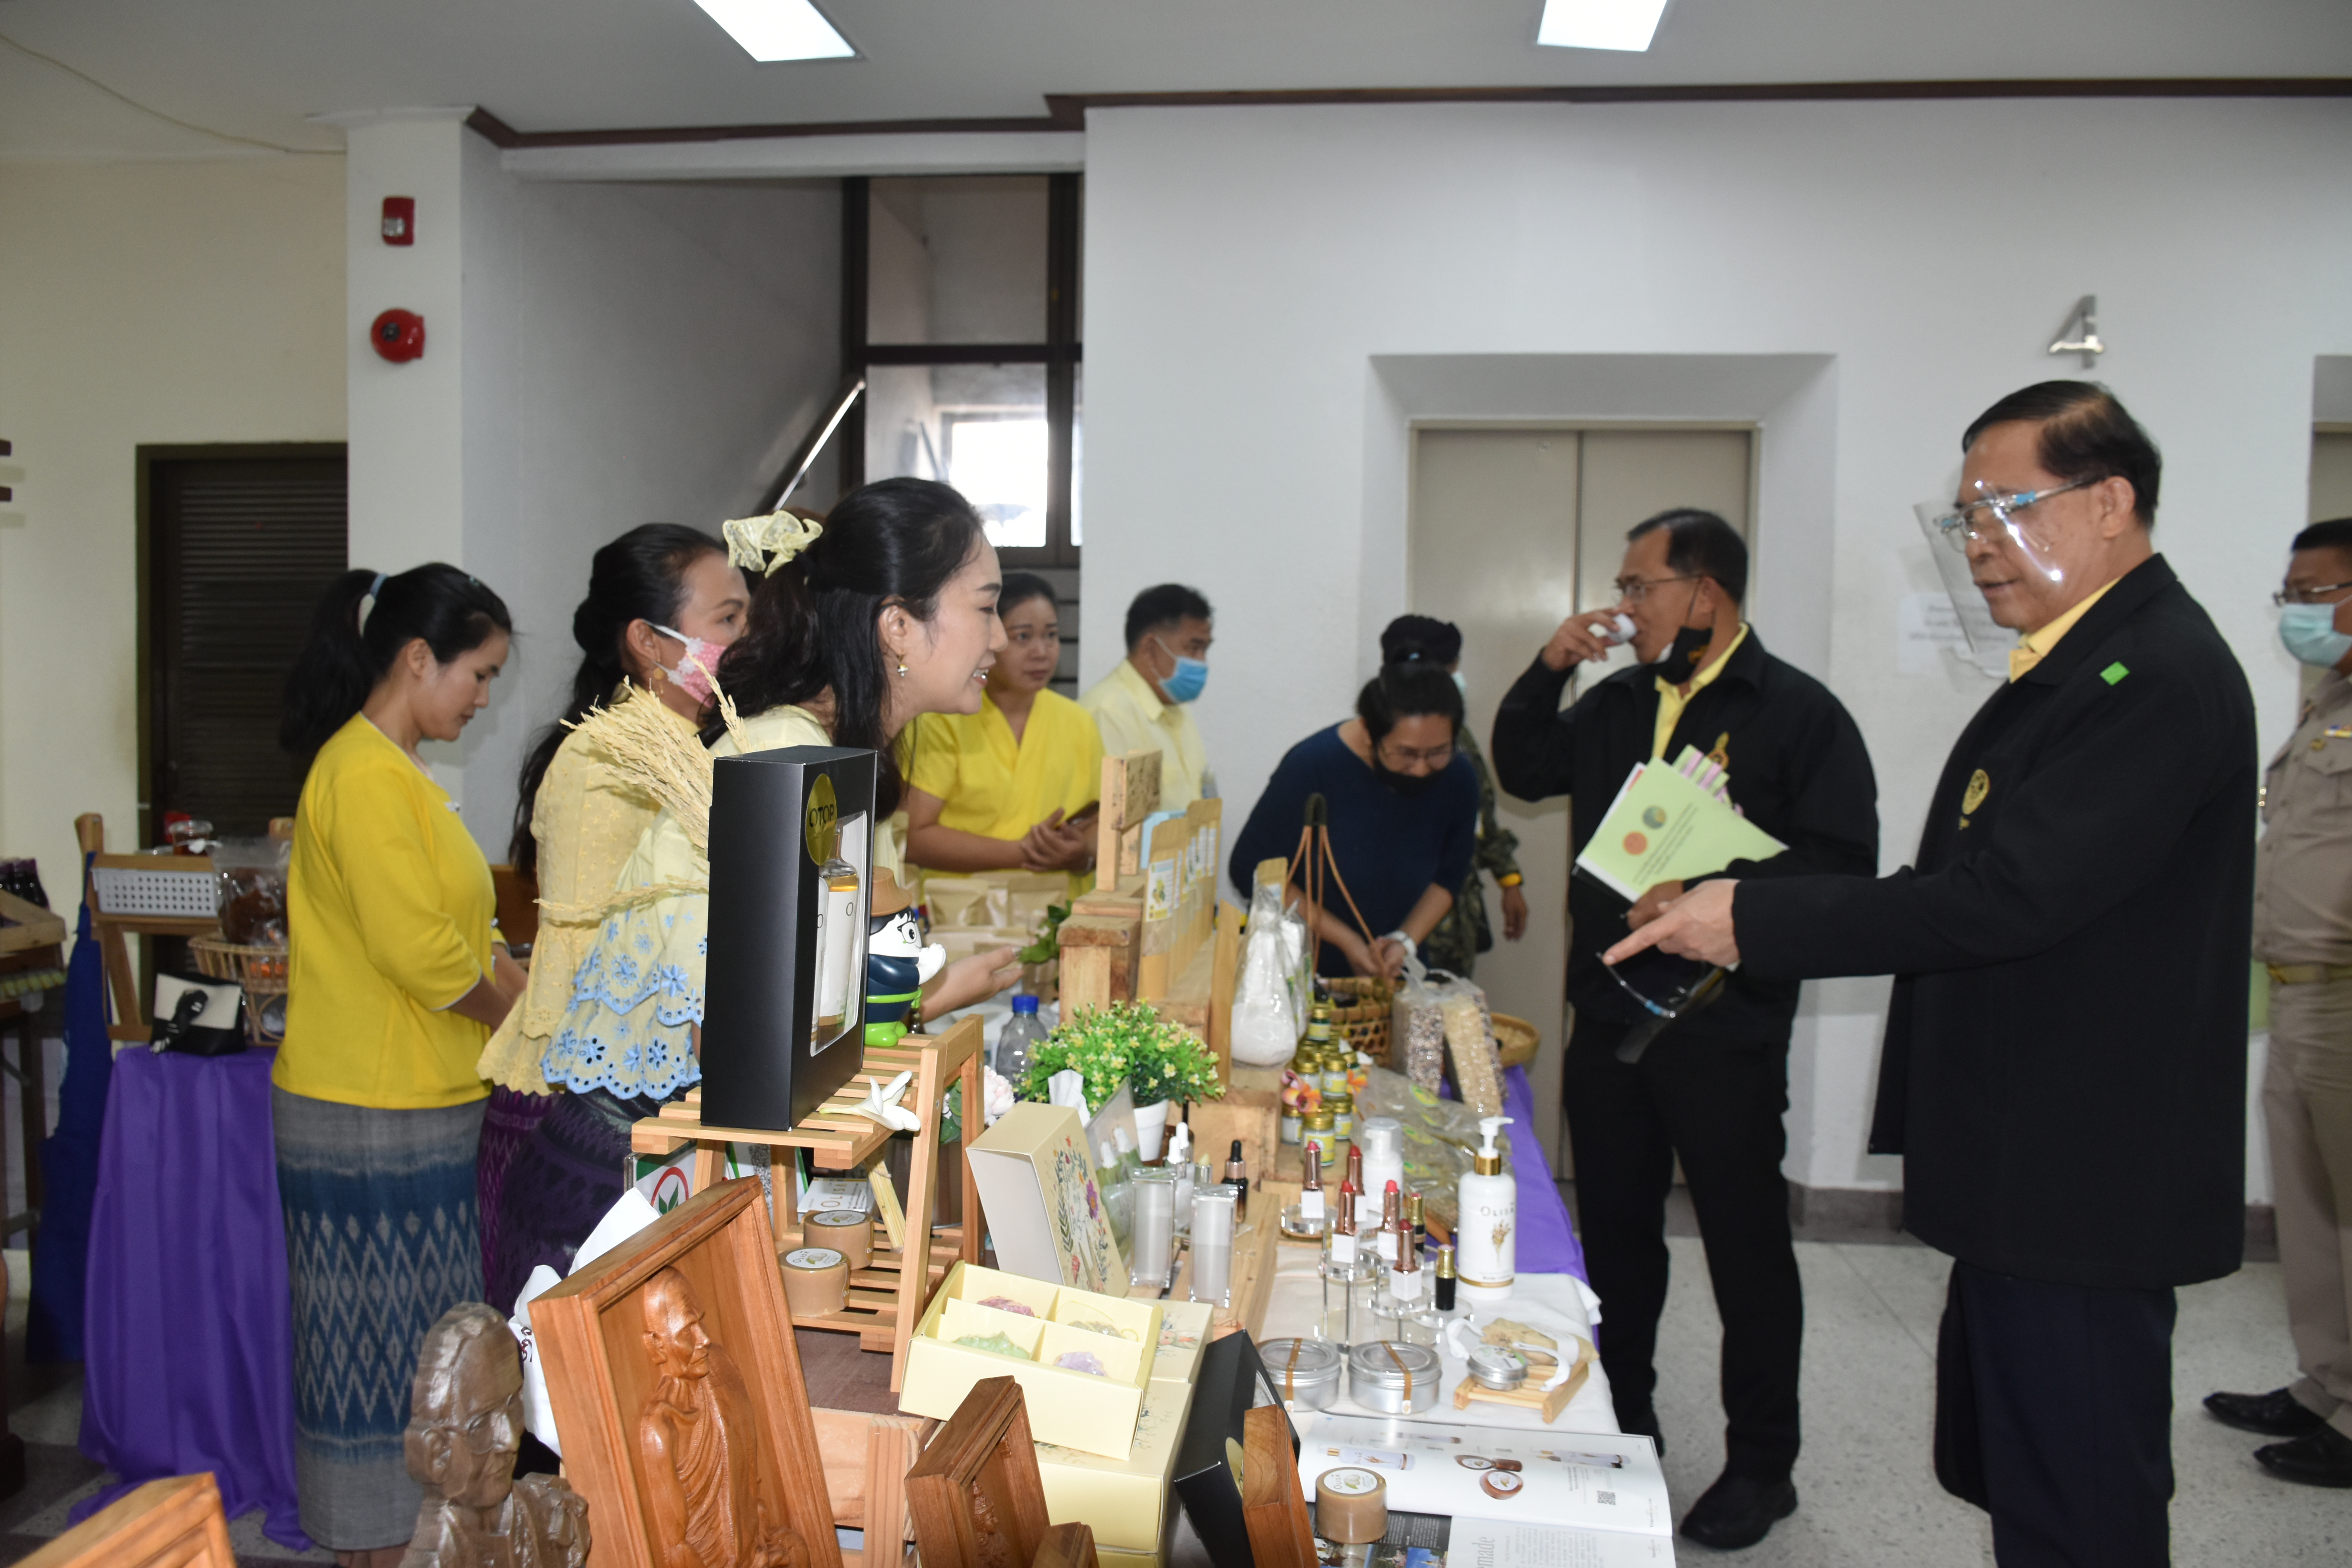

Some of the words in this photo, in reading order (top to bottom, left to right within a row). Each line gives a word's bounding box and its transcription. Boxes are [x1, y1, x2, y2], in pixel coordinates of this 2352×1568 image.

[2047, 295, 2105, 369] 4
[809, 804, 835, 828] OTOP
[1471, 1536, 1495, 1568] made
